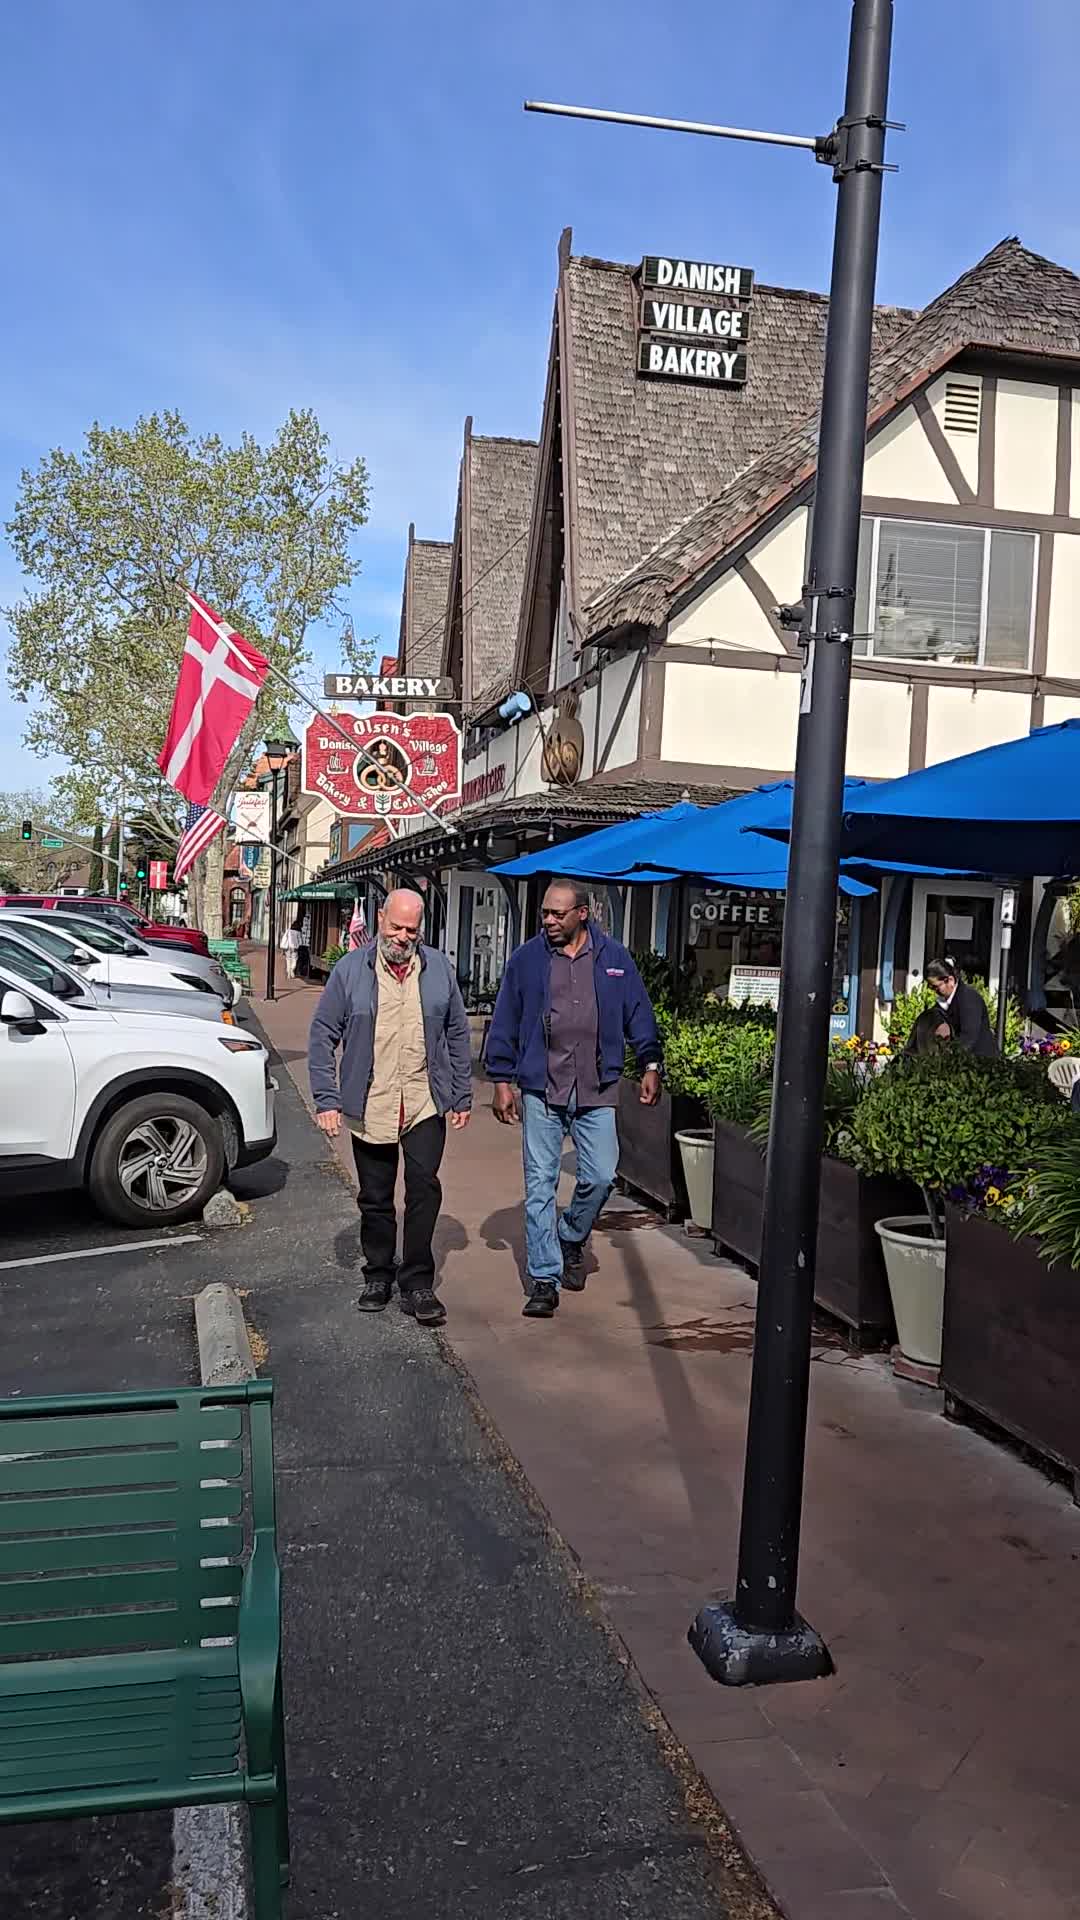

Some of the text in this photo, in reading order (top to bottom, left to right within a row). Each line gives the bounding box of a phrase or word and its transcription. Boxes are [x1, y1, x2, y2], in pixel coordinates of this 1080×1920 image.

[657, 259, 741, 295] DANISH
[652, 301, 743, 338] VILLAGE
[649, 344, 738, 379] BAKERY
[335, 676, 441, 697] BAKERY
[353, 719, 412, 738] Olsen's
[408, 740, 448, 755] Village
[315, 771, 351, 807] Bakery
[357, 795, 368, 809] &
[392, 781, 448, 810] Cofeshop
[690, 903, 770, 924] COFFEE
